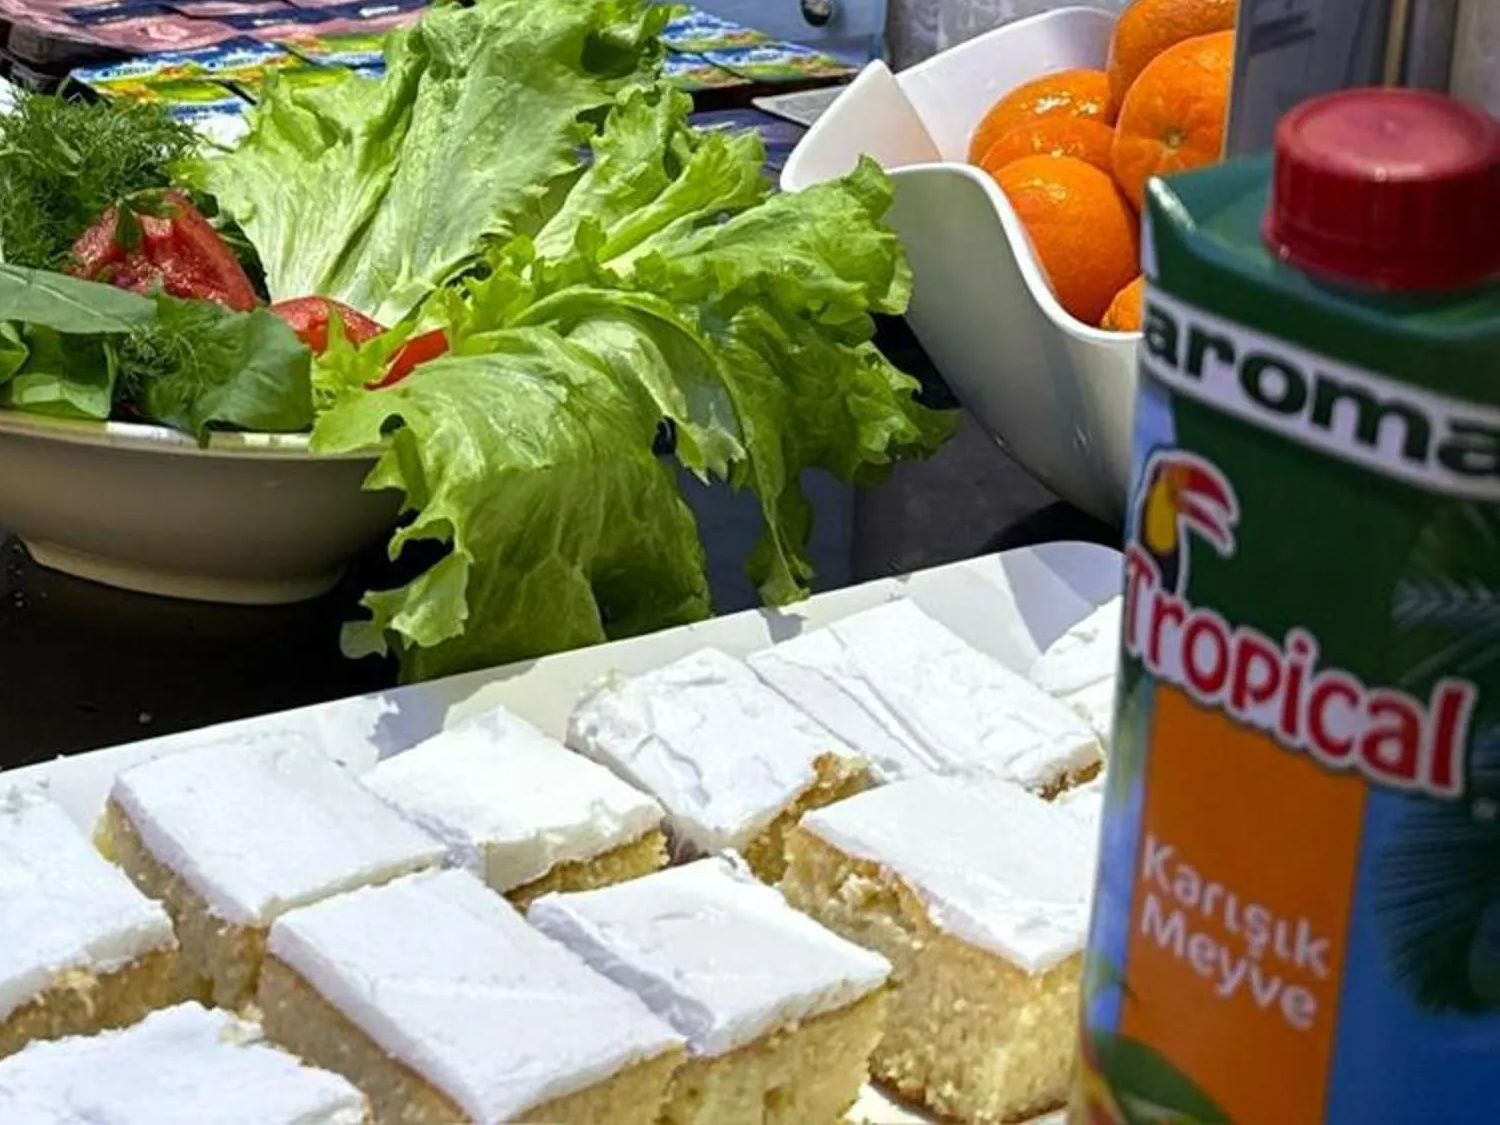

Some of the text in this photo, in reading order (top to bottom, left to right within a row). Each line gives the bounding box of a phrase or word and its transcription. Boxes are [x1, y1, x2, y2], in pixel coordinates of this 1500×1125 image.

[1142, 302, 1500, 474] aroma
[1124, 547, 1468, 789] Tropical
[1140, 894, 1320, 1030] Meyve
[1143, 835, 1332, 979] Karışık
